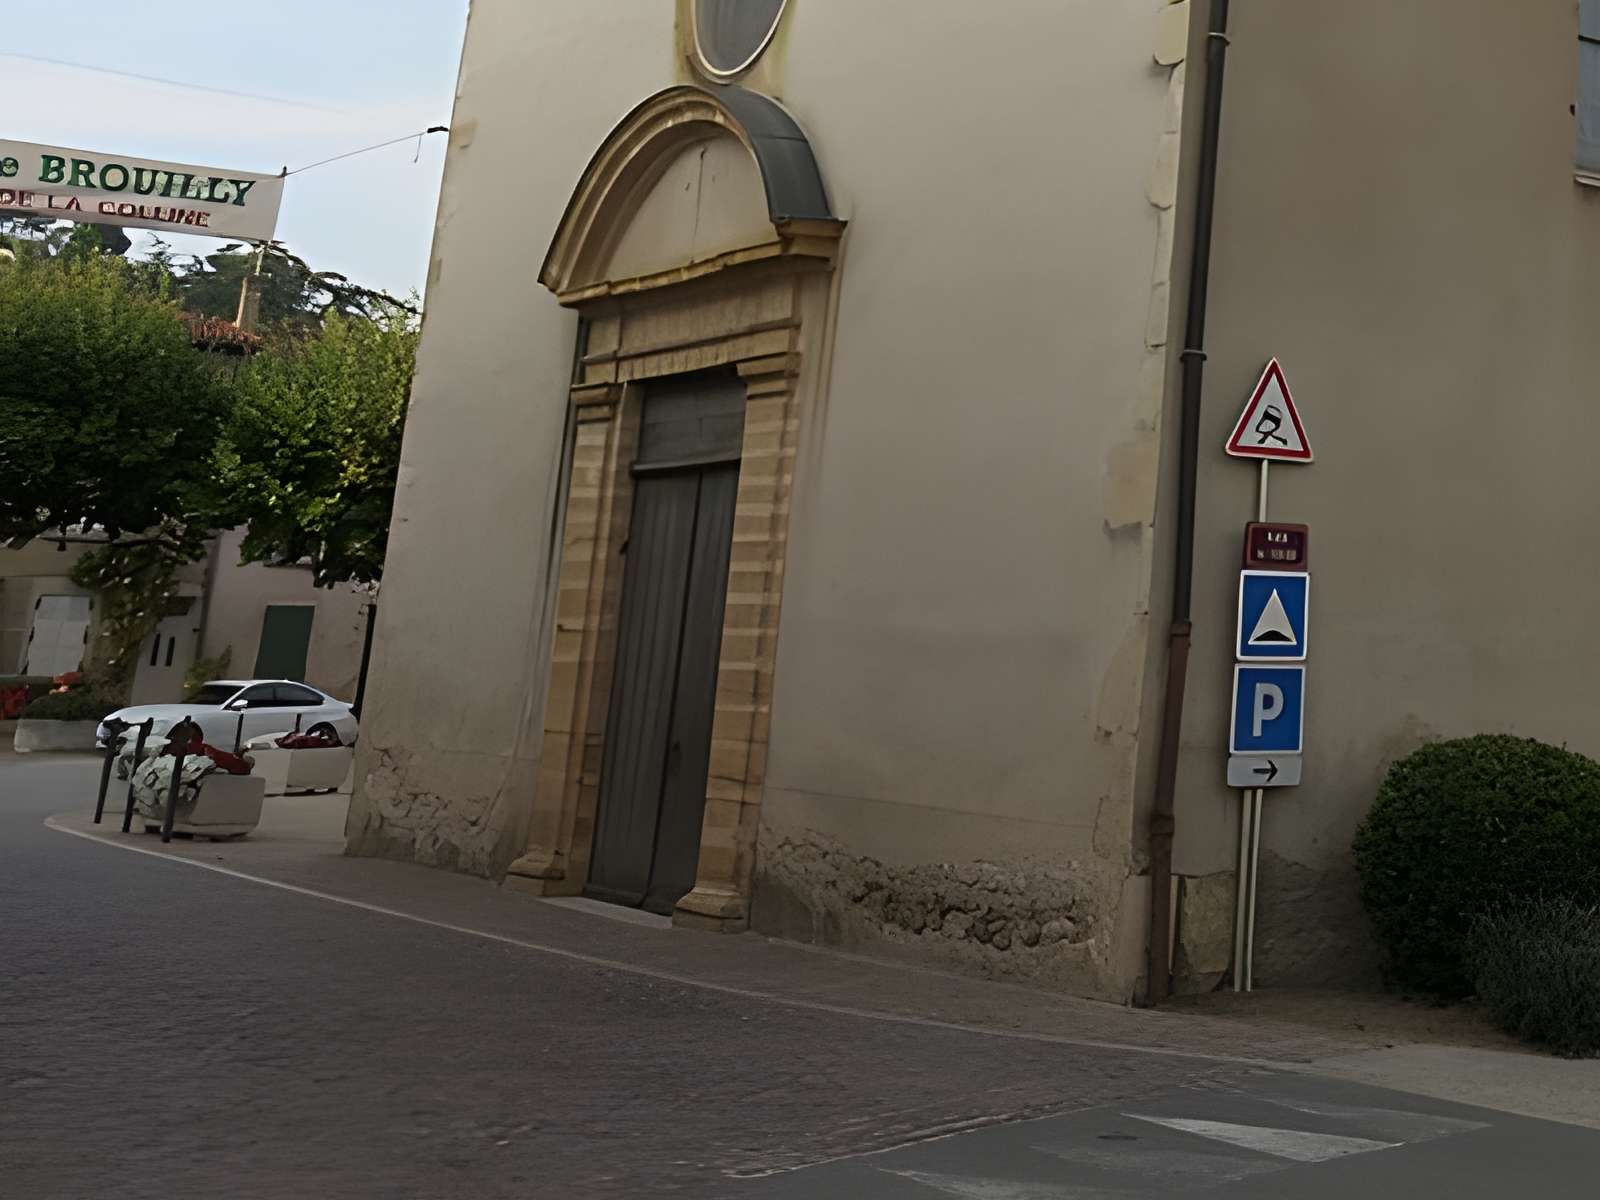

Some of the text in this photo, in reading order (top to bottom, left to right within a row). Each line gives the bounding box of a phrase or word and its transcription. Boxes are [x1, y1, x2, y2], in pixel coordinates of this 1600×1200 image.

[39, 154, 257, 206] BROUILLY
[47, 195, 82, 211] LA
[1252, 682, 1284, 737] P
